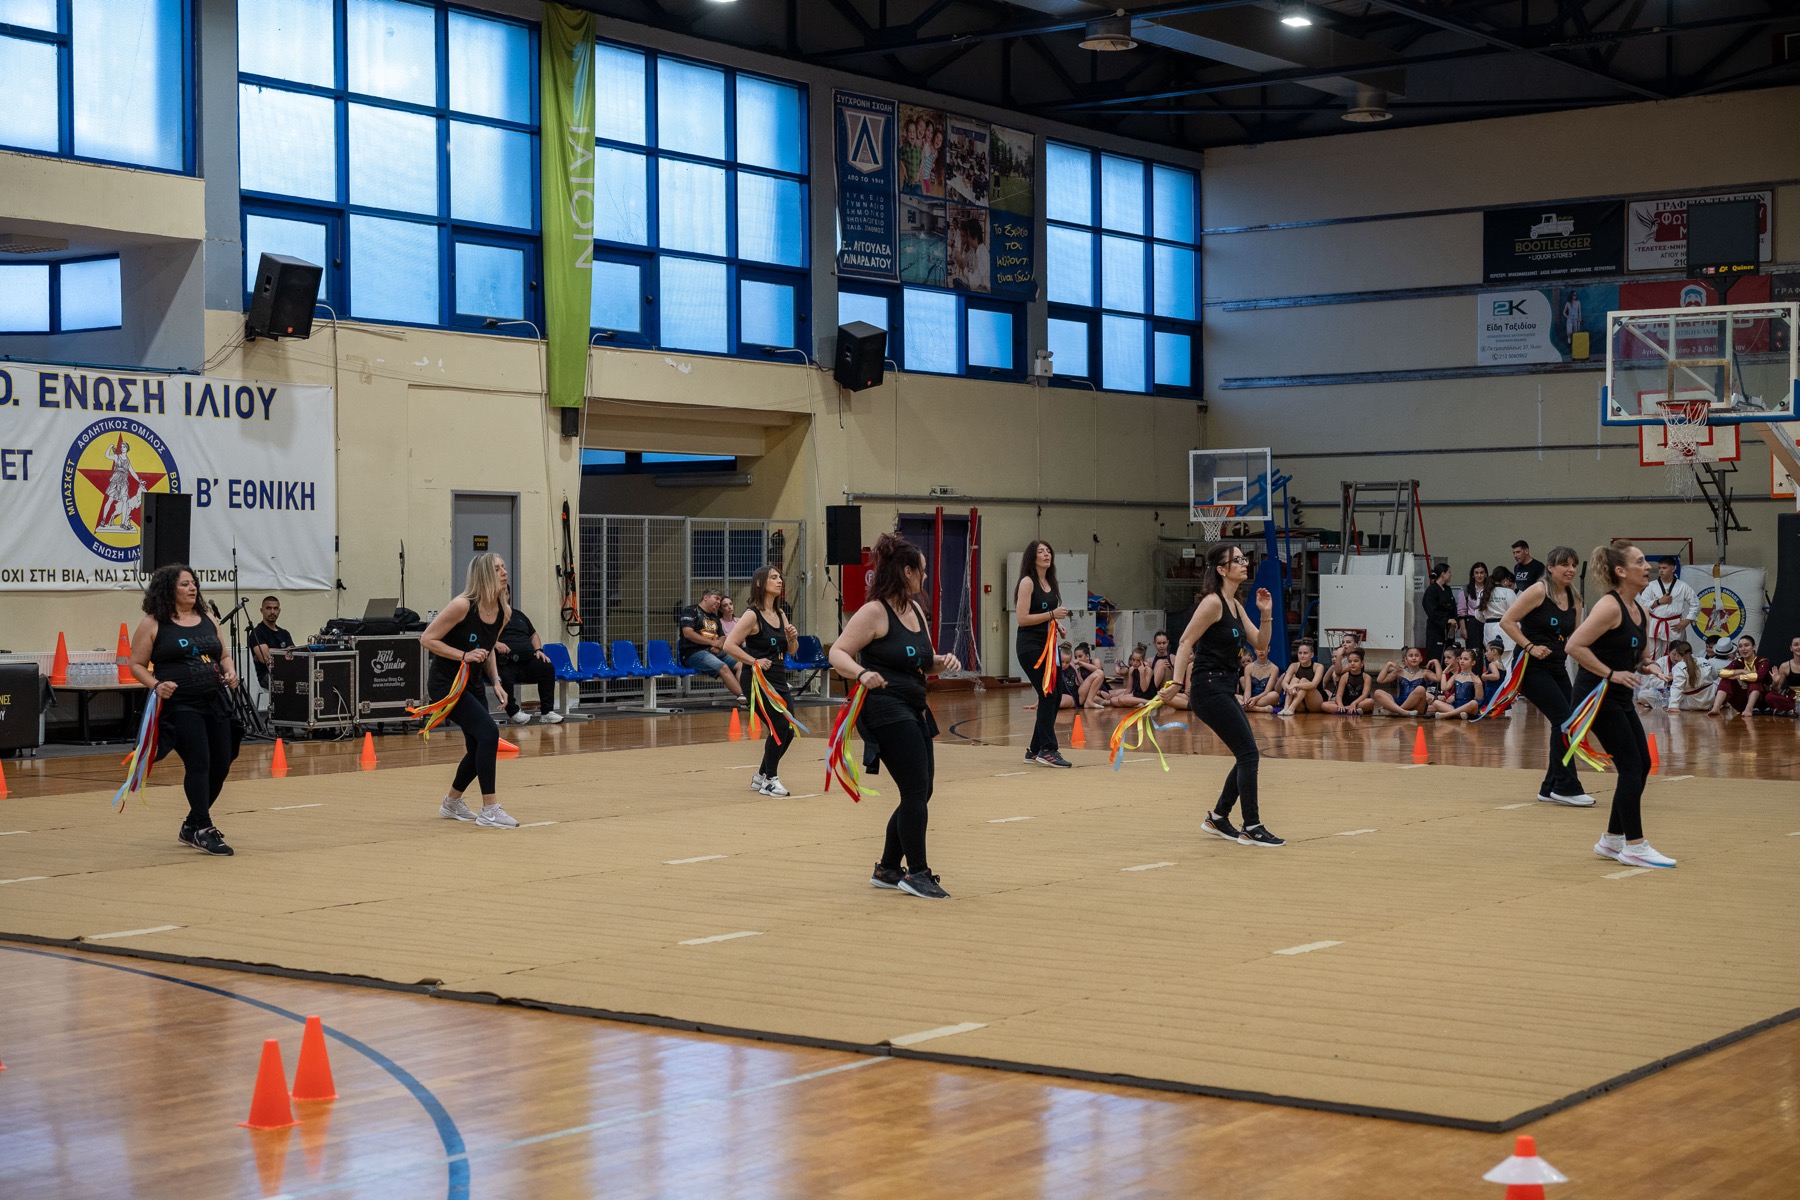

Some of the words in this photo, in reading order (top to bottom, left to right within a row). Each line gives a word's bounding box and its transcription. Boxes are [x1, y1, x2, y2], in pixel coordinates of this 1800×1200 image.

[836, 95, 871, 109] ΣΥΓΧΡΟΝΗ
[872, 102, 893, 113] ΣΧΟΛΗ
[846, 200, 884, 211] ΓΥΜΝΑΣΙΟ
[846, 208, 884, 218] ΔΗΜΟΤΙΚΟ
[993, 223, 1002, 235] Το
[1005, 241, 1022, 251] του
[1515, 237, 1591, 252] BOOTLEGGER
[1532, 252, 1552, 260] LIQUOR
[1552, 251, 1573, 259] STORES
[1493, 299, 1528, 317] 2K
[1486, 323, 1503, 332] Είδη
[1504, 321, 1537, 331] Ταξιδίου
[38, 372, 165, 416] ΕΝΩΣΗ
[184, 381, 278, 421] ΙΛΙΟΥ
[76, 420, 129, 450] ΑΘΛΗΤΙΚΟΣ
[130, 423, 167, 455] ΟΜΙΛΟΣ
[64, 458, 76, 517] ΜΠΑΣΚΕΤ
[228, 478, 316, 511] ΕΘΝΙΚΗ
[92, 541, 125, 560] ΕΝΩΣΗ
[1, 569, 24, 582] ΟΧΙ
[30, 569, 56, 583] ΣΤΗ
[62, 569, 90, 584] ΒΙΑ,
[94, 569, 118, 583] ΝΑΙ
